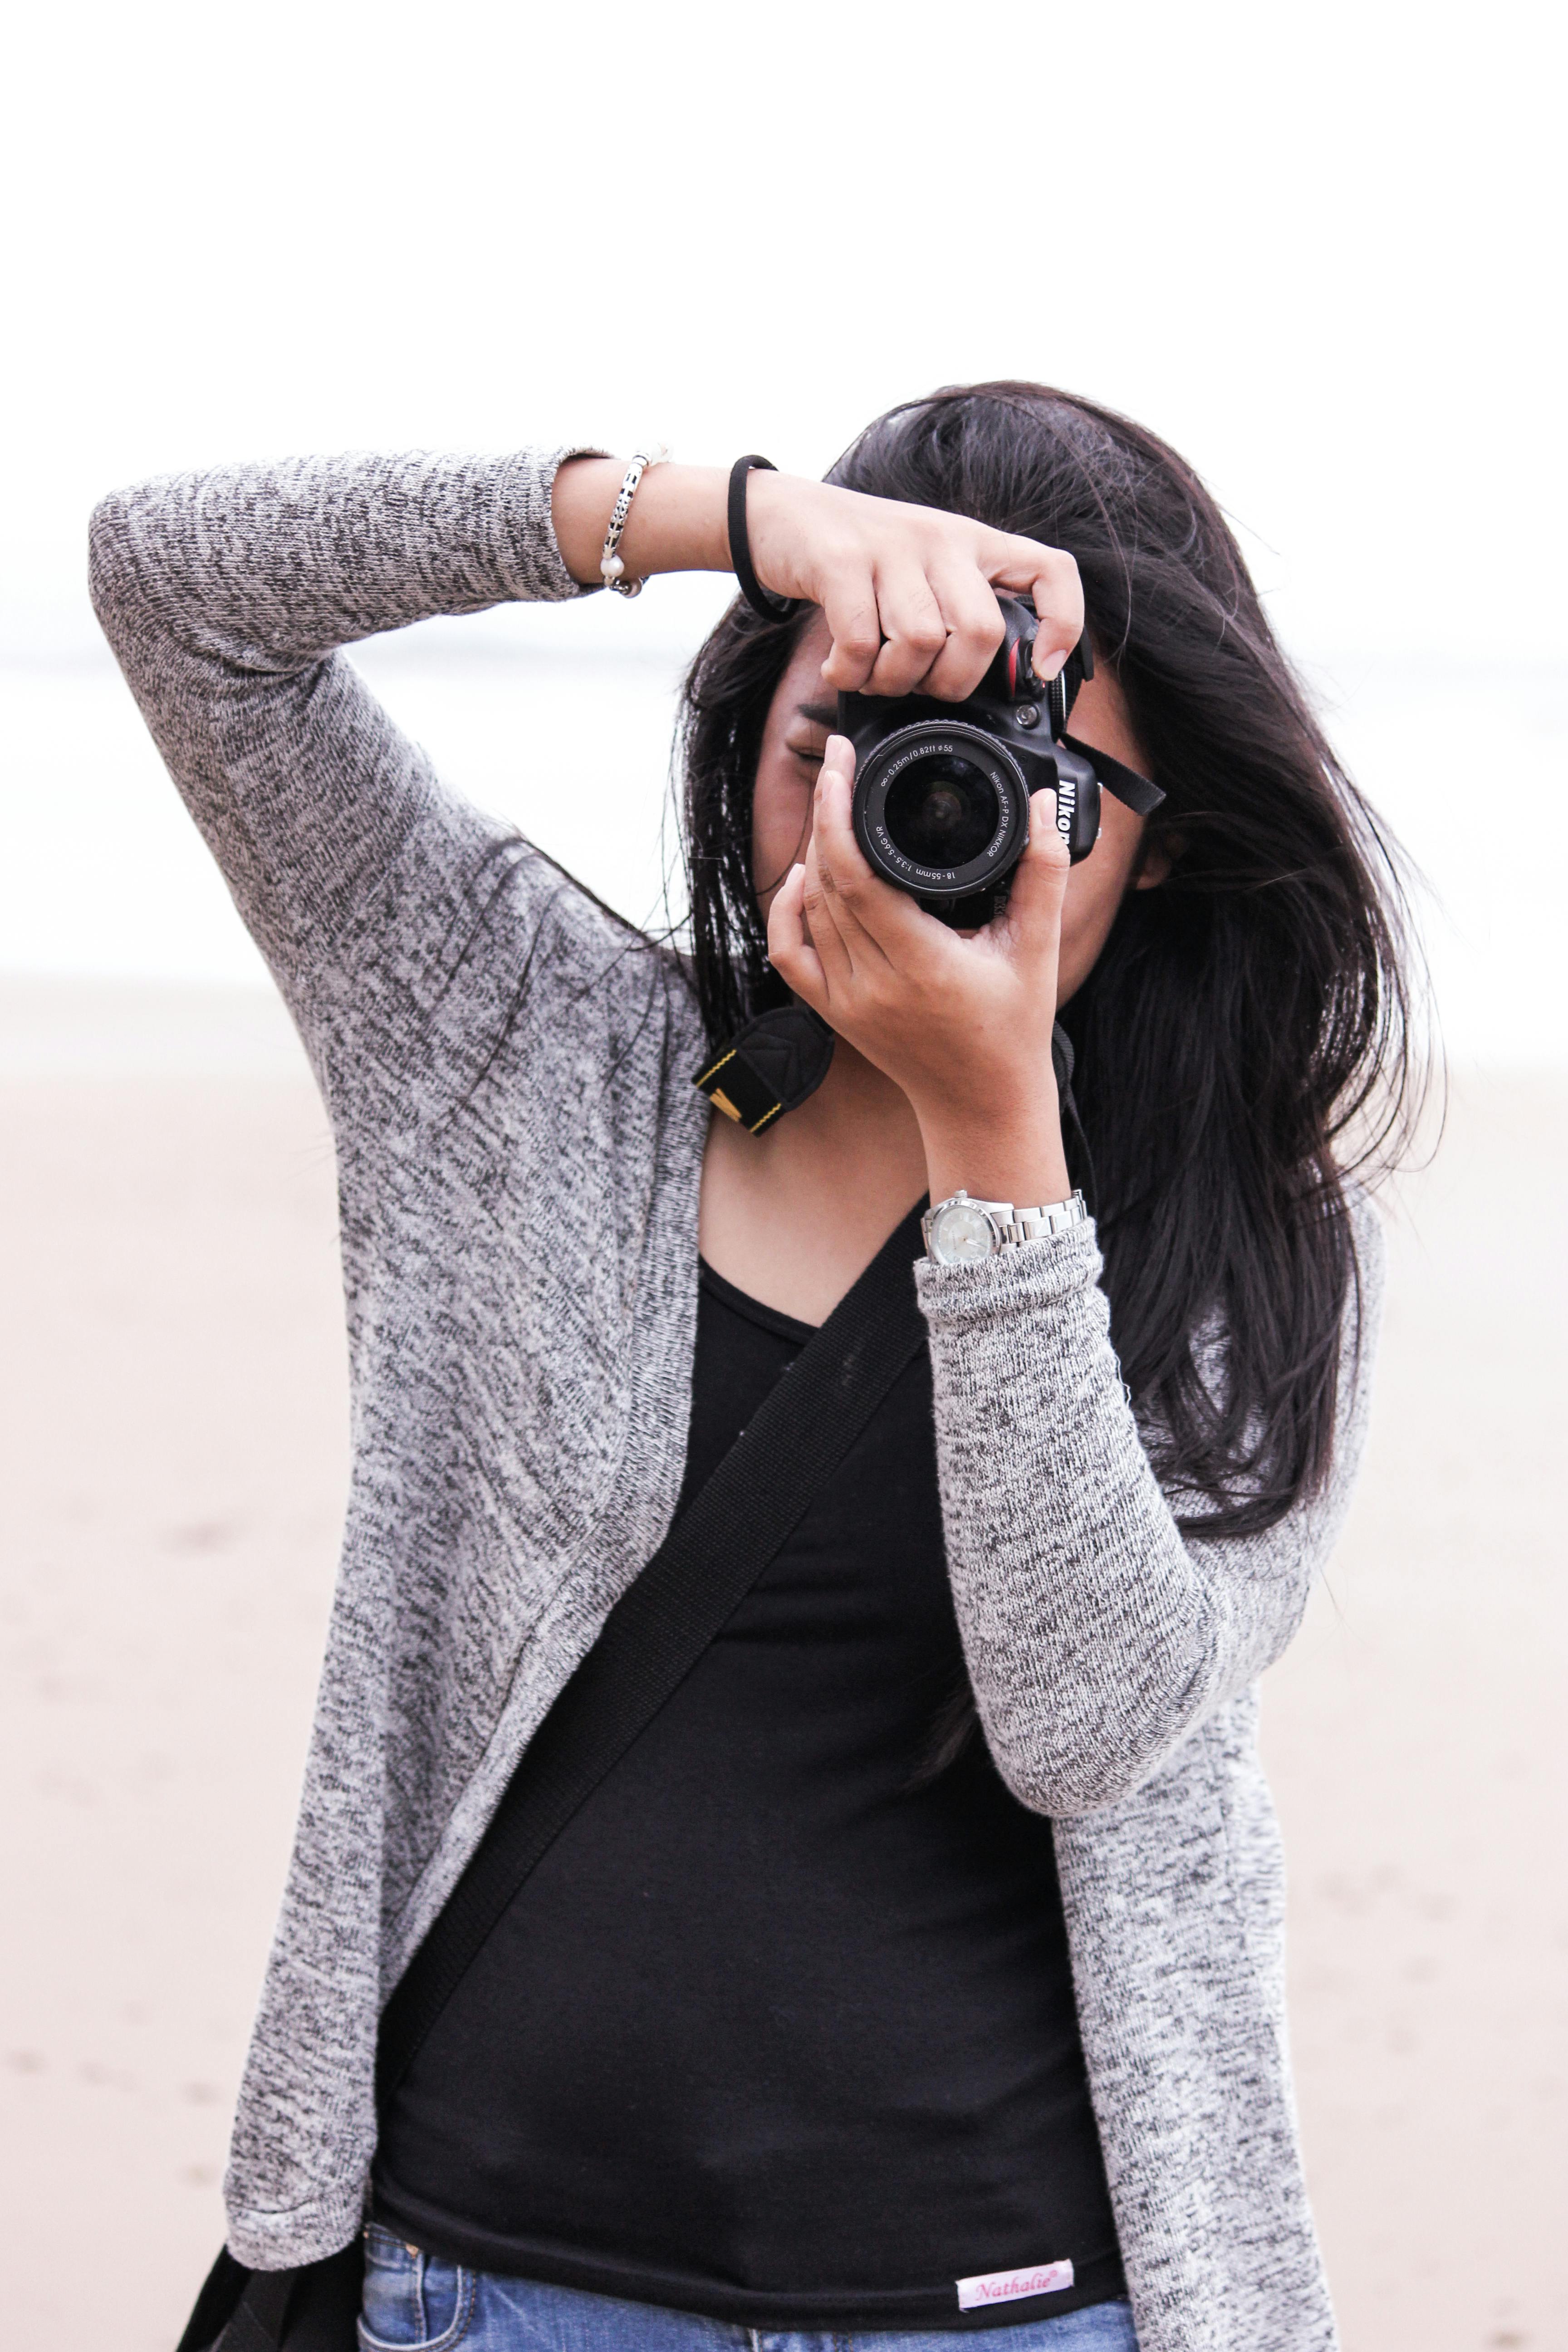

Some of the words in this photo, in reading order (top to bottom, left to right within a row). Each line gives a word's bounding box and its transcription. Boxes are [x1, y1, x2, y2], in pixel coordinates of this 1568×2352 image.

[990, 771, 1004, 794] Nikon
[1000, 796, 1009, 814] AF-P
[1001, 816, 1009, 828] DX
[876, 826, 883, 838] VR
[987, 829, 1006, 857] NIKKOR
